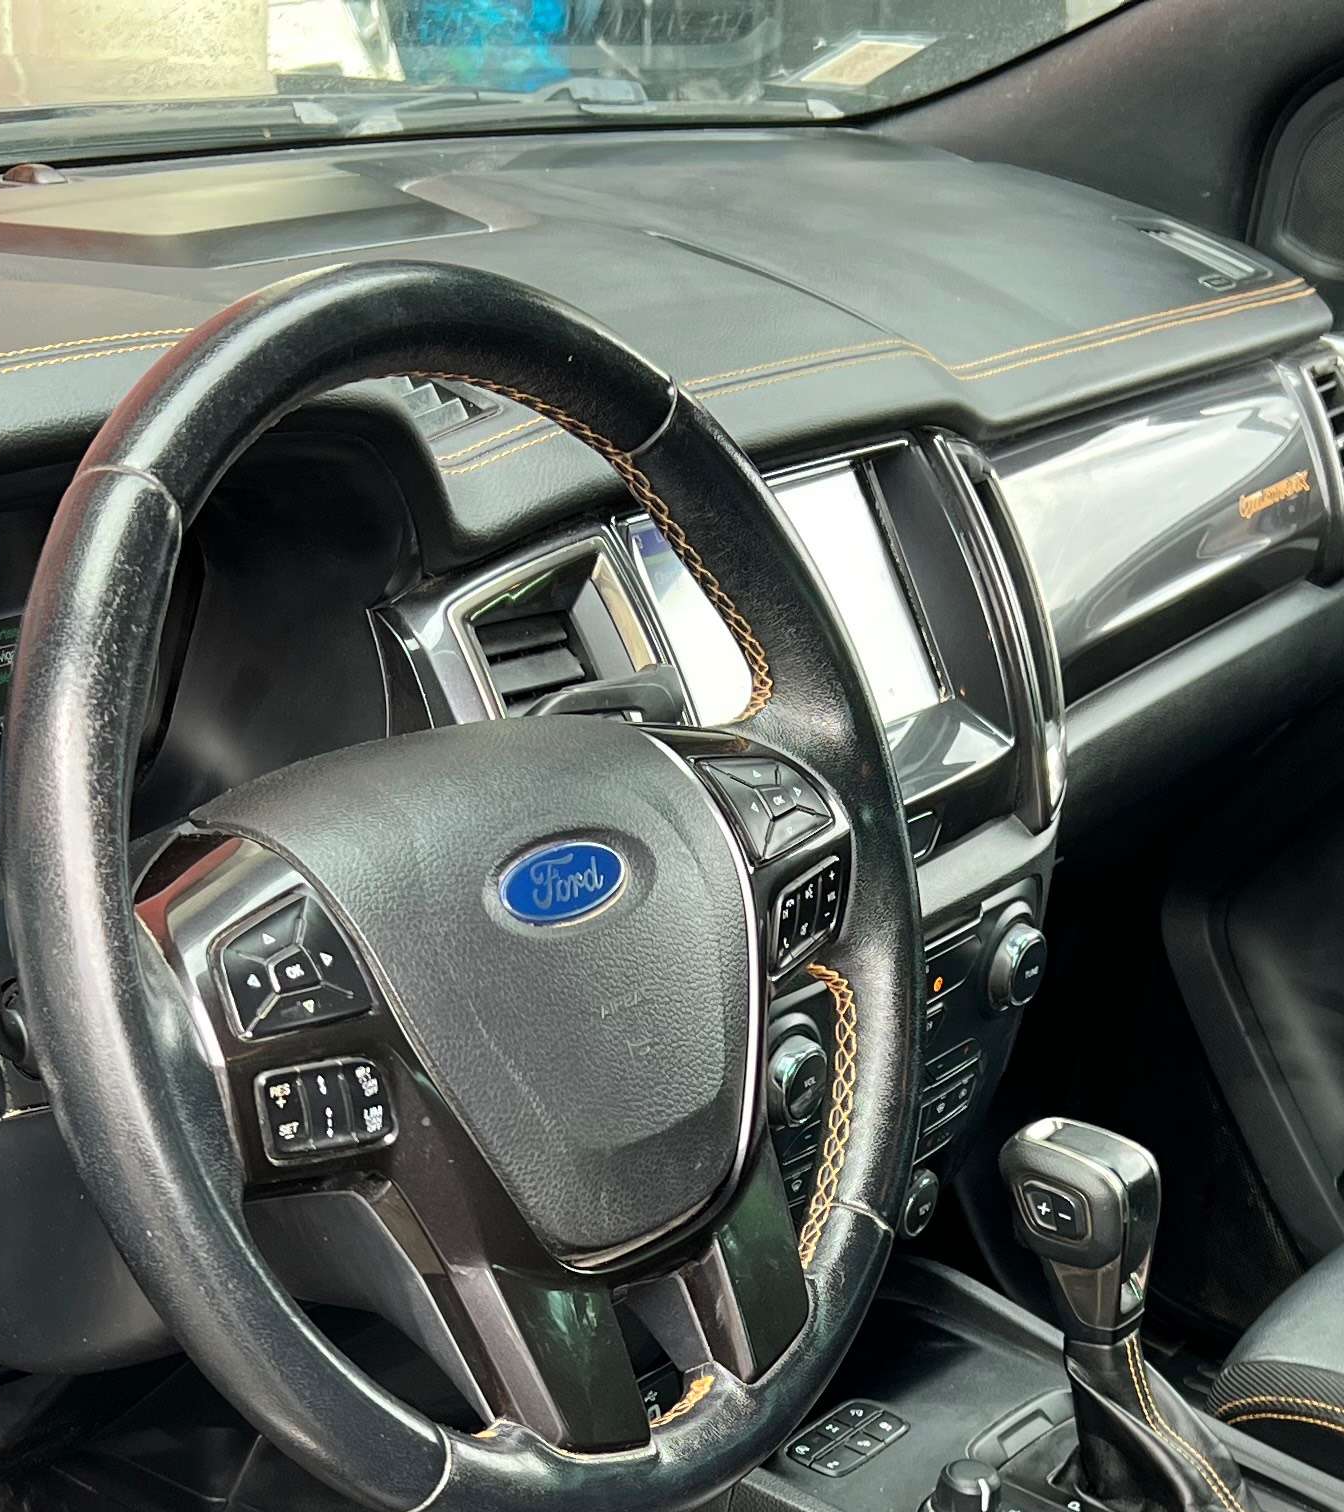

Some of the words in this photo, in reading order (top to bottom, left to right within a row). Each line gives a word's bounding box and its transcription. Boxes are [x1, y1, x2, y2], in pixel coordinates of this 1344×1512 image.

[530, 853, 604, 909] Ford
[278, 1122, 299, 1135] SET
[1067, 1501, 1081, 1512] P
